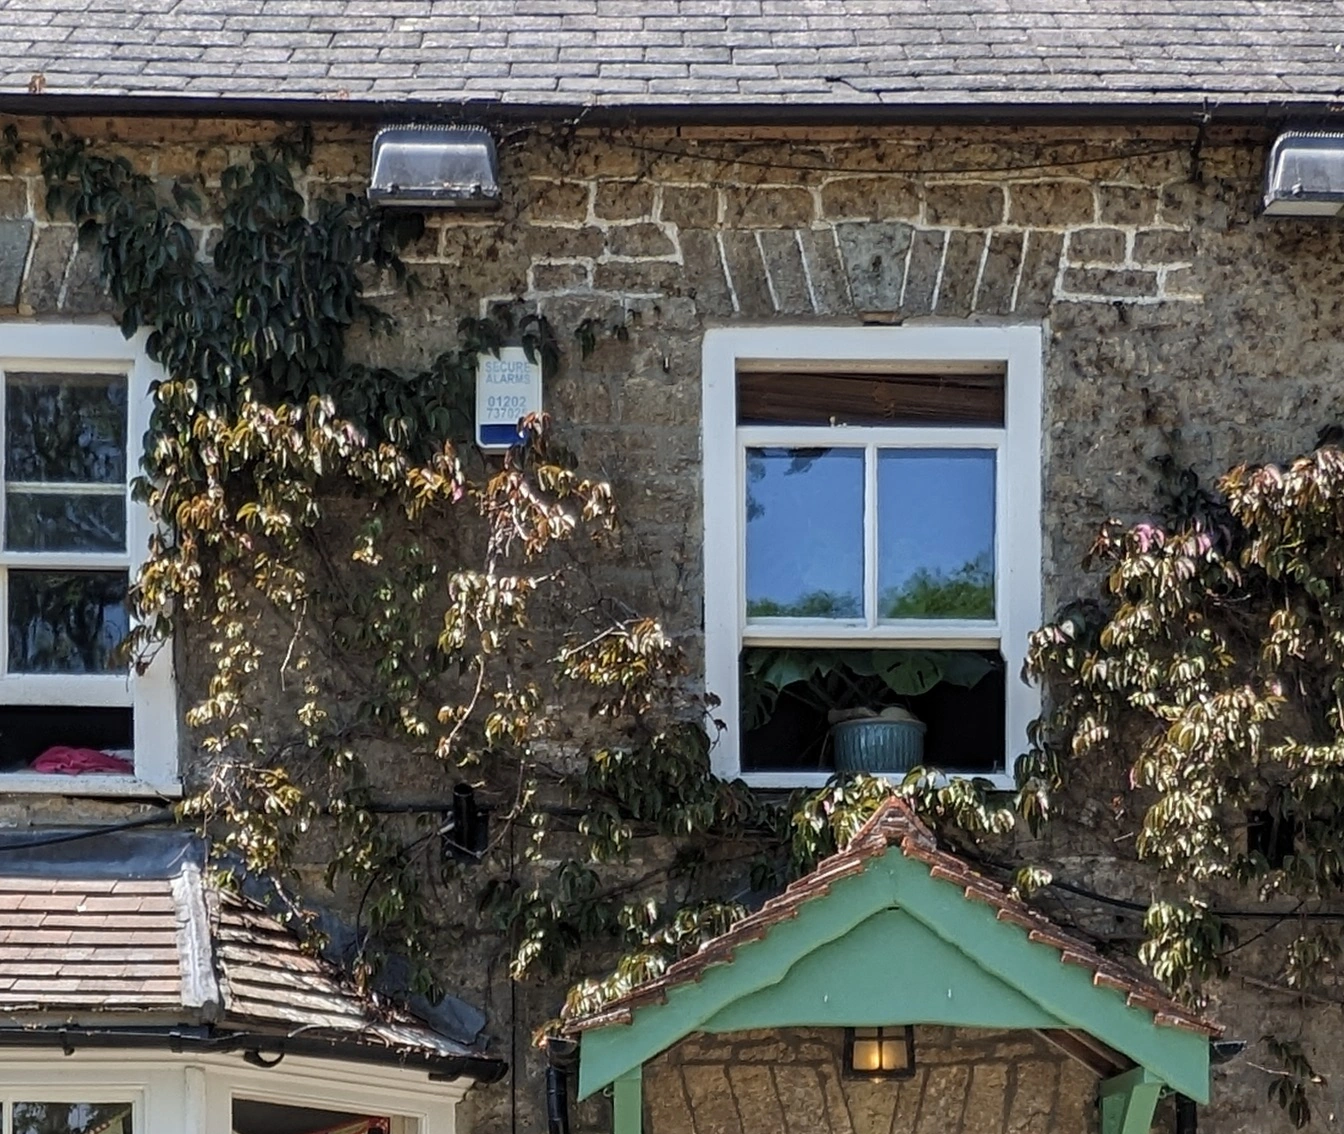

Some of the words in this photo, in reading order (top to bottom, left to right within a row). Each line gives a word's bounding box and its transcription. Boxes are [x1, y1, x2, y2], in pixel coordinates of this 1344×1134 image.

[485, 361, 531, 373] SECURE
[485, 374, 531, 384] ALARMS
[487, 396, 527, 407] 01202
